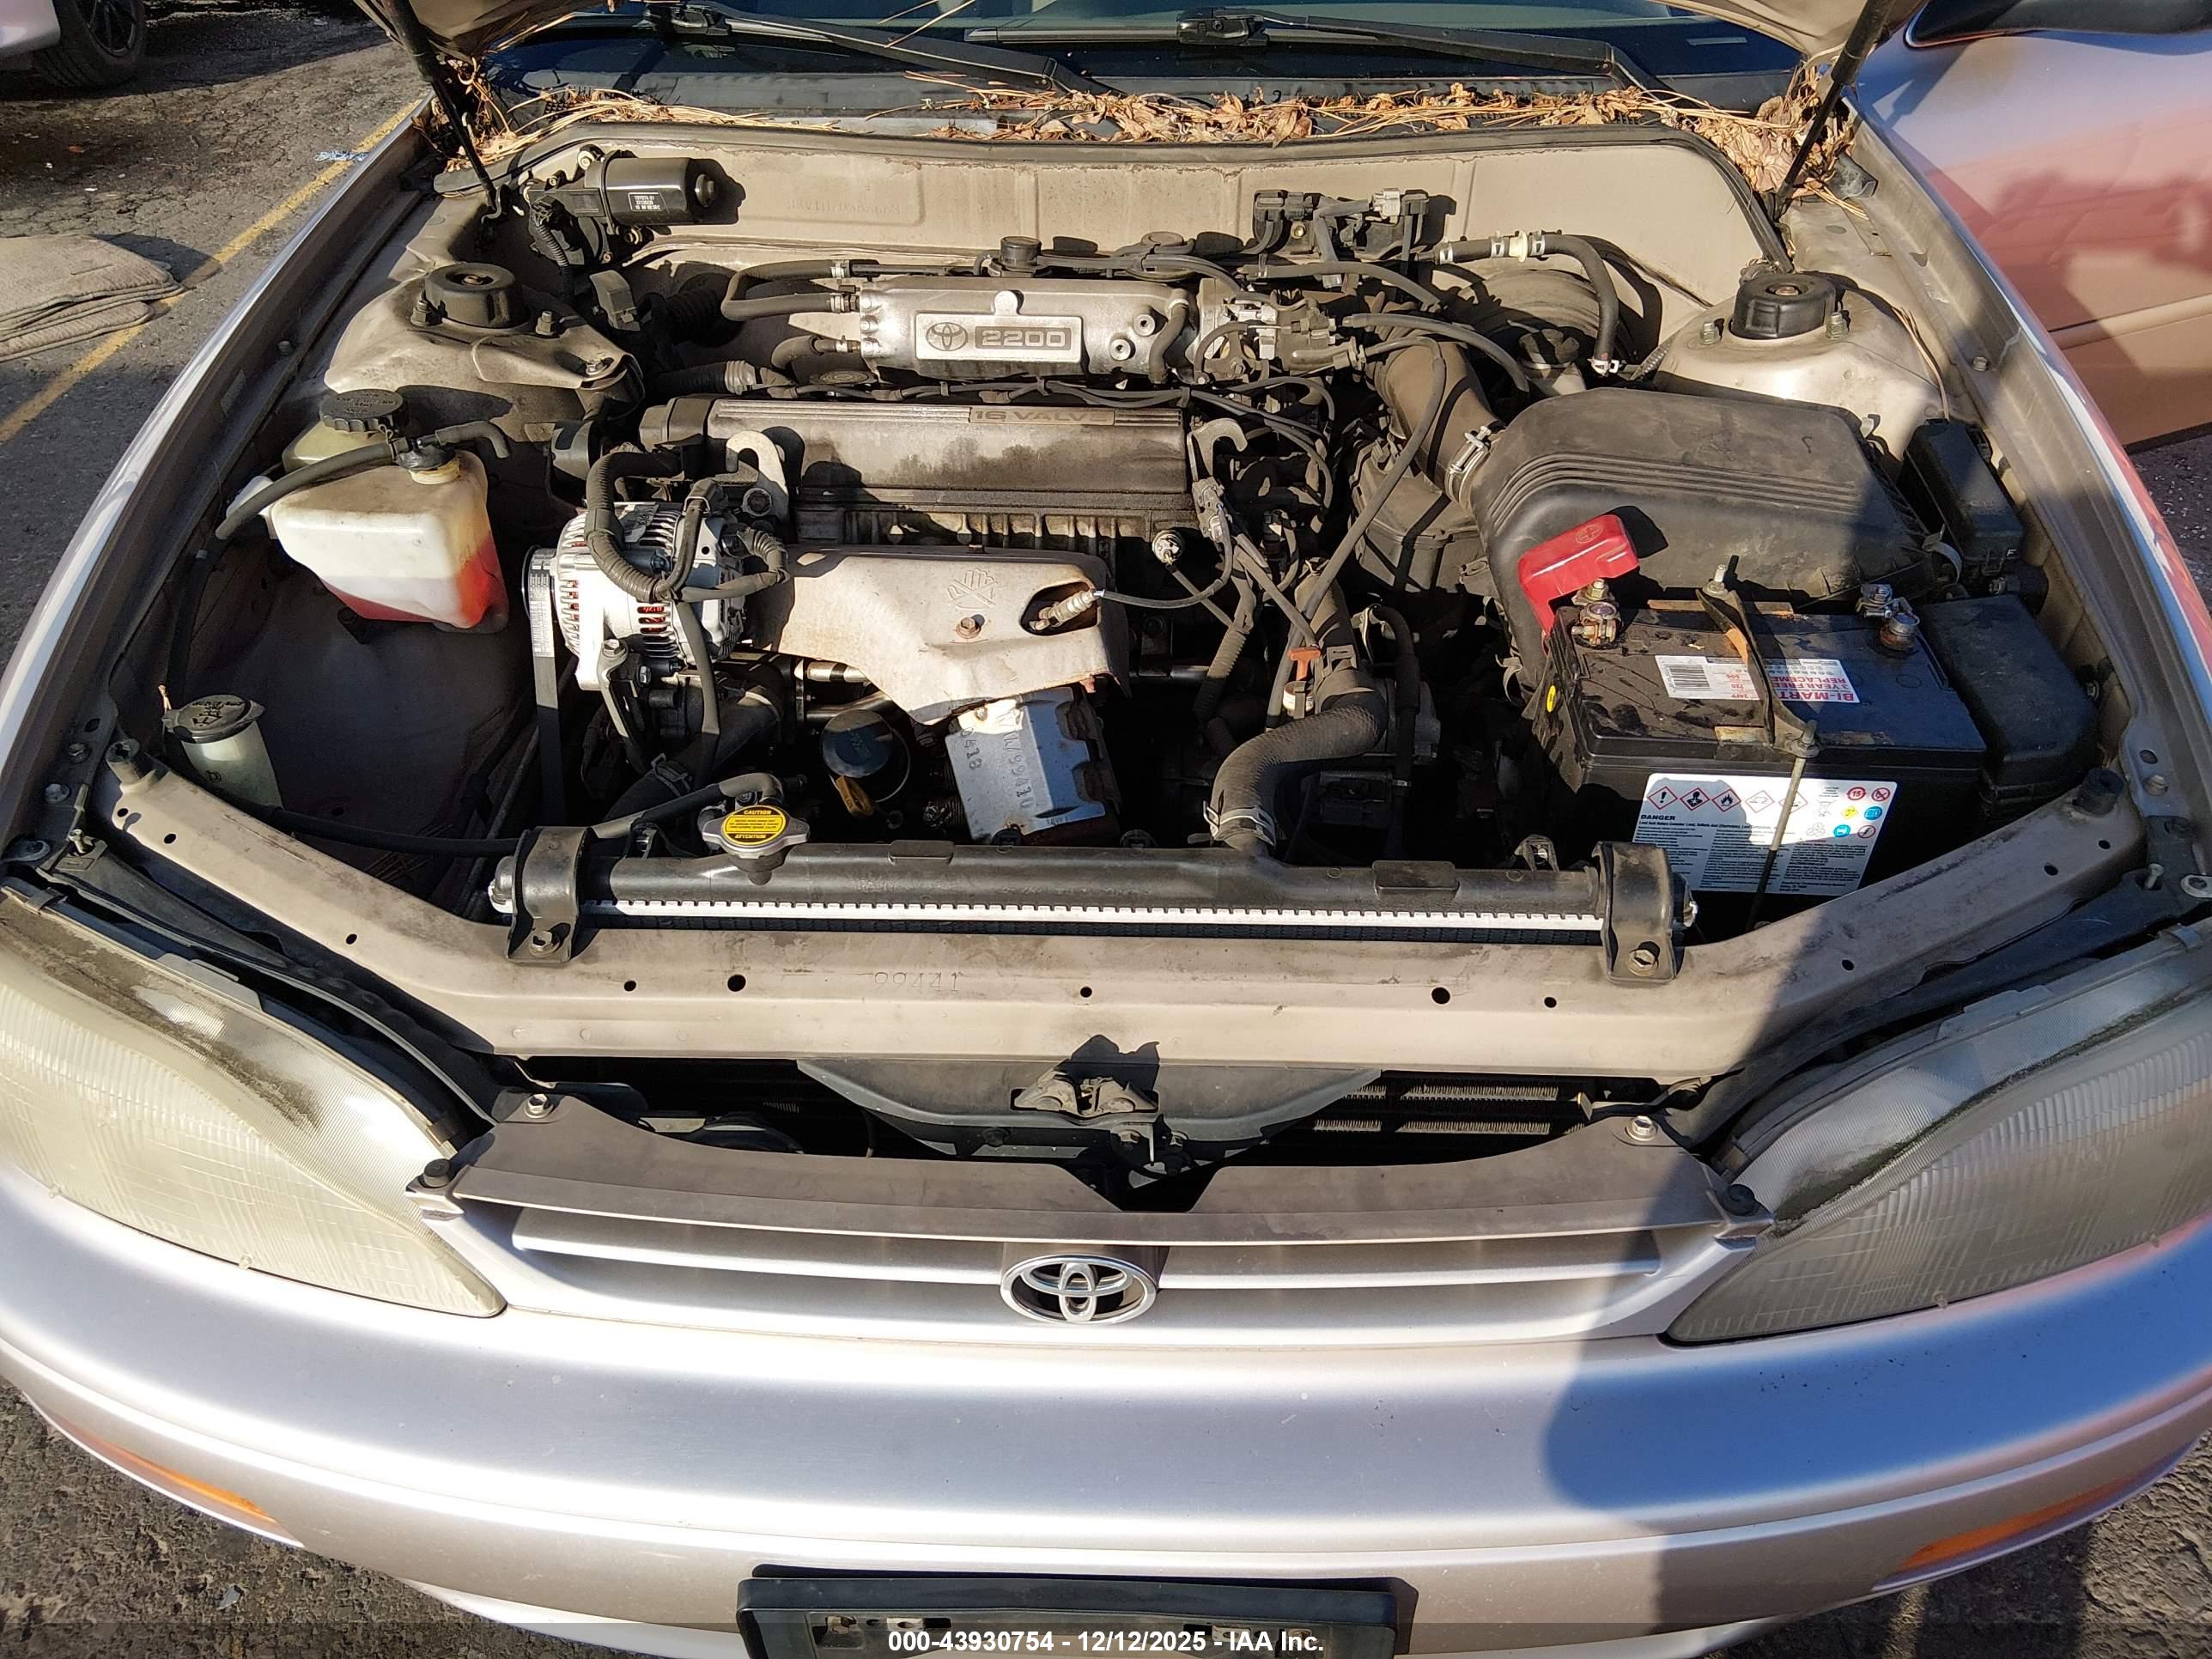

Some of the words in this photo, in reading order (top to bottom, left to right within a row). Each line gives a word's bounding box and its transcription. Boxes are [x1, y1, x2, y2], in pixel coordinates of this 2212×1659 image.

[981, 330, 1067, 347] 2200
[975, 410, 1006, 422] 16
[1778, 691, 1855, 702] BI-MART
